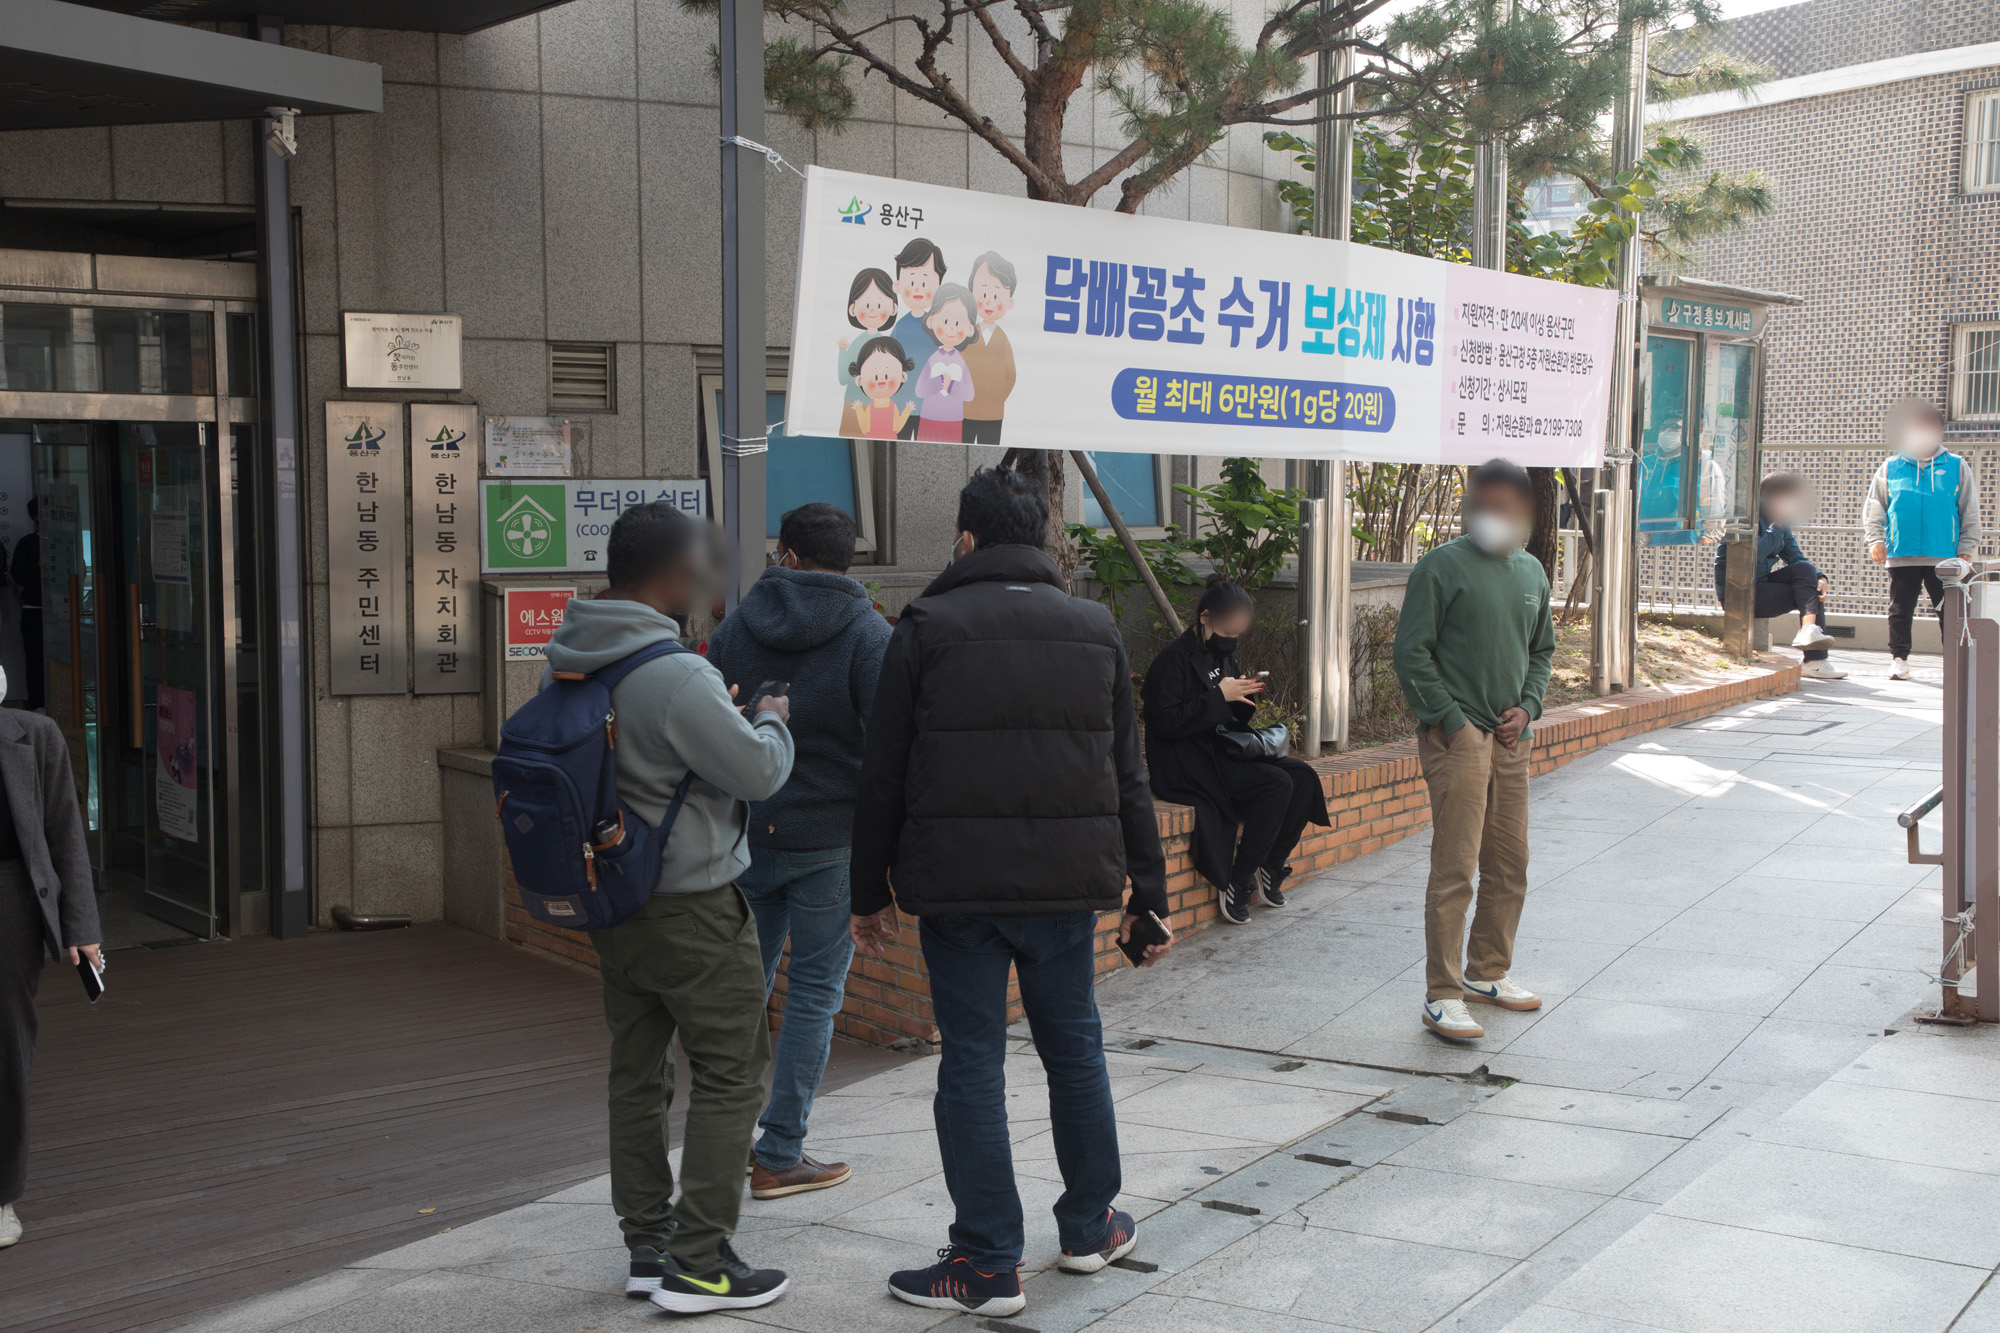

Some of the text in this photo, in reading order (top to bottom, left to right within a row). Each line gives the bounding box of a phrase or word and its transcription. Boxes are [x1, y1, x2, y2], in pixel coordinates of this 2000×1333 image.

[879, 203, 924, 229] 용산구
[1043, 255, 1436, 367] 담배꽁초 수거 보상제 시행
[1462, 302, 1494, 331] 지원자격
[1500, 308, 1509, 331] 만
[1510, 311, 1528, 333] 20세
[1530, 313, 1545, 337] 이상
[1546, 315, 1575, 340] 용산구민
[1460, 339, 1492, 366] 신청방법
[1499, 344, 1525, 369] 용산구청
[1526, 347, 1537, 370] 5층
[1538, 348, 1569, 373] 자원순환과
[1570, 352, 1593, 375] 방문접수
[1134, 375, 1383, 426] 월 최대 6만원(1g당 20원)
[1459, 375, 1491, 401] 신청기간
[1498, 379, 1527, 404] 상시모집
[1497, 414, 1533, 438] 자원순환과
[1543, 418, 1582, 437] 2199-7308
[356, 472, 380, 674] 한남동 주민센터
[435, 473, 459, 673] 한남동 자치회관
[520, 609, 564, 626] 에스원
